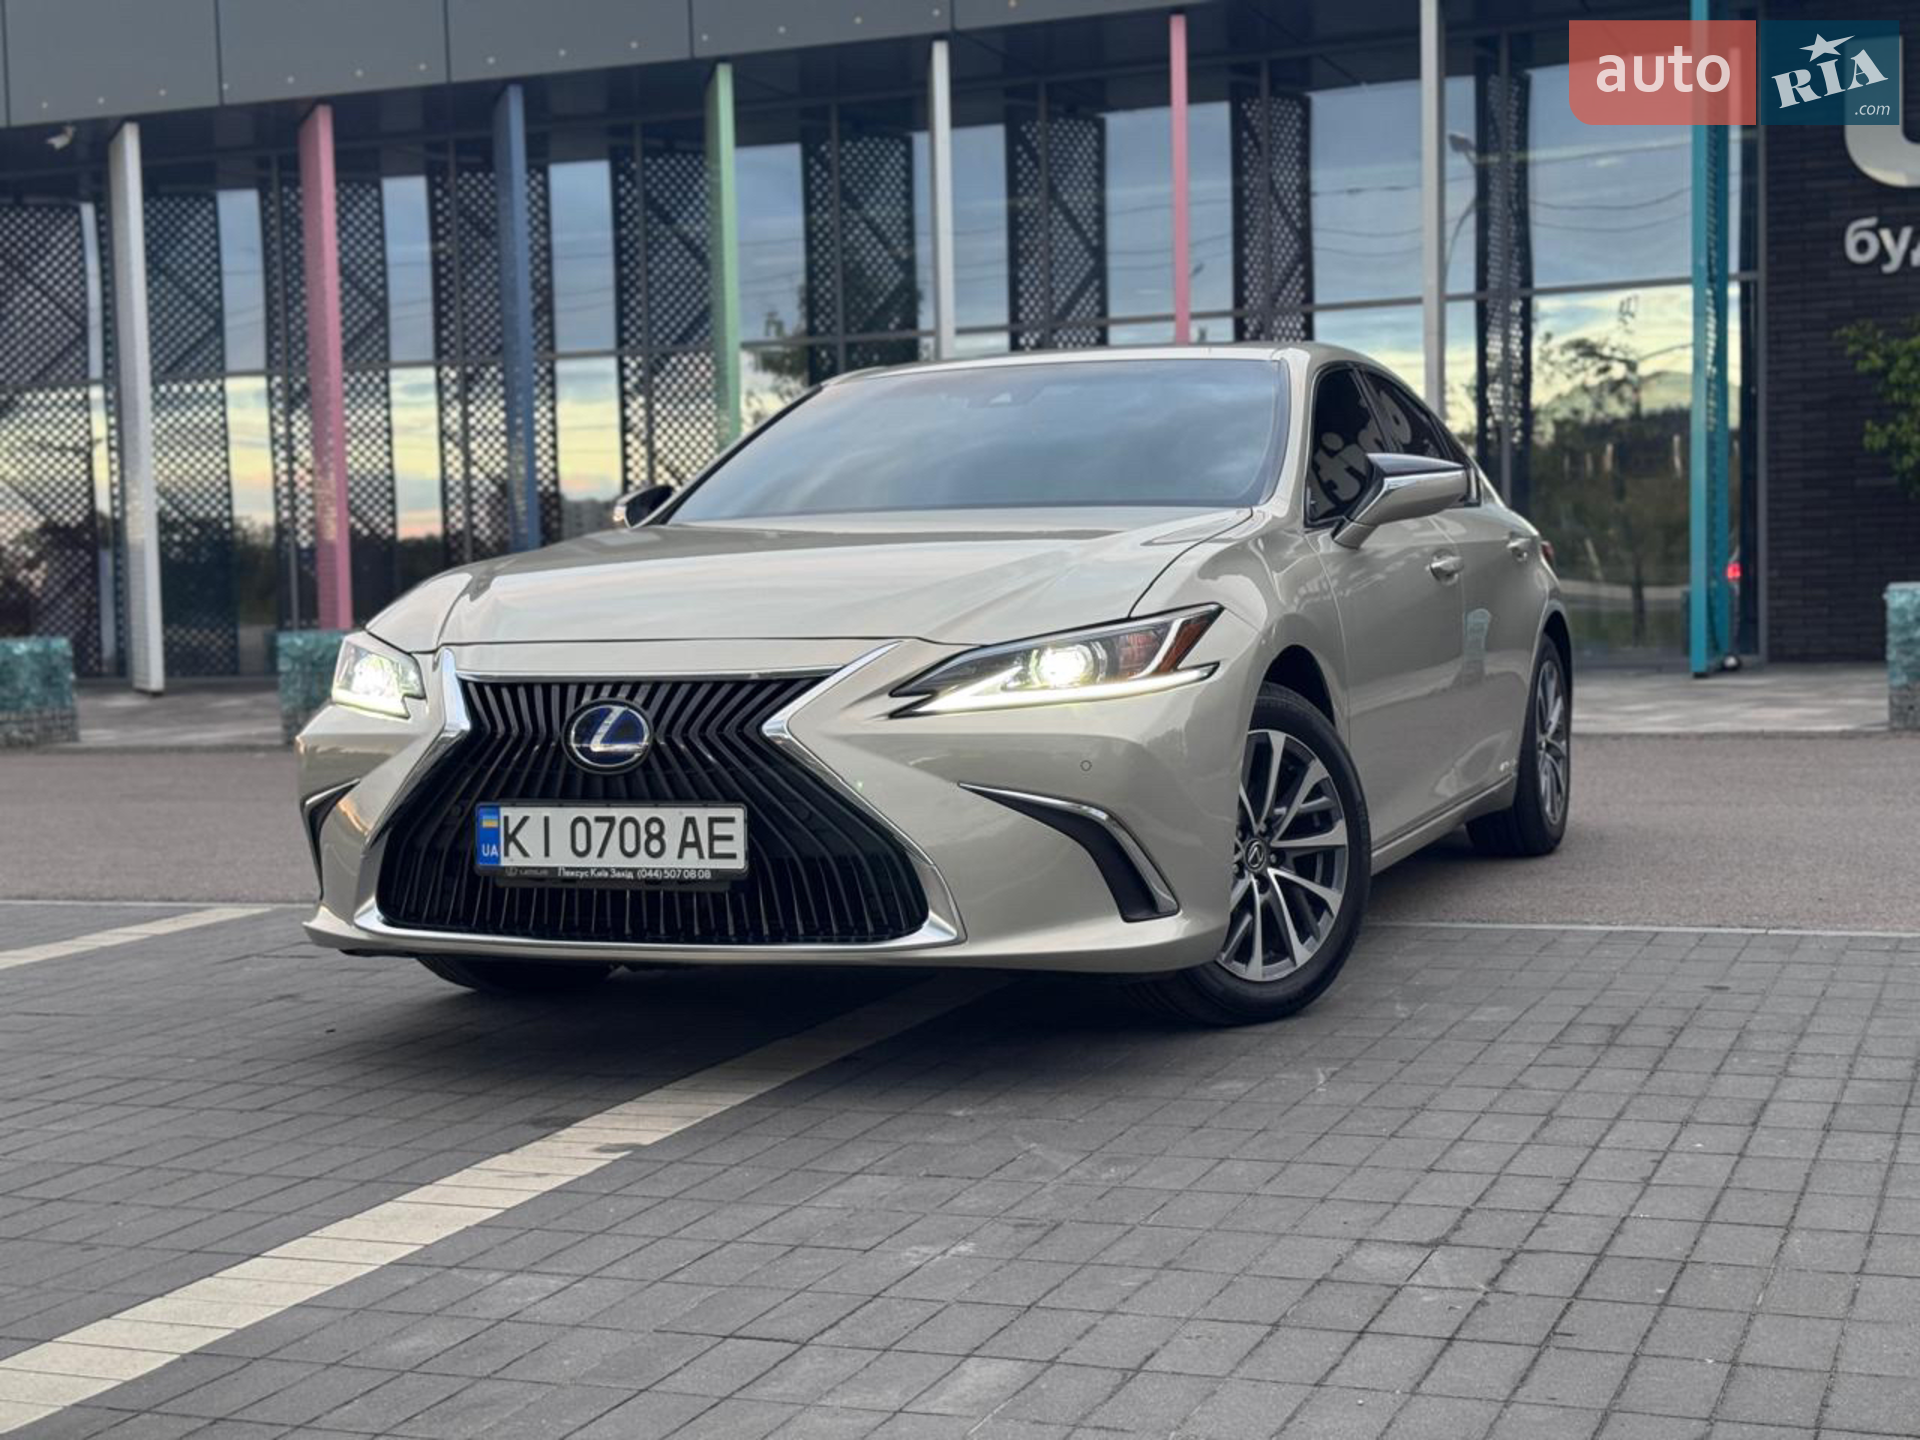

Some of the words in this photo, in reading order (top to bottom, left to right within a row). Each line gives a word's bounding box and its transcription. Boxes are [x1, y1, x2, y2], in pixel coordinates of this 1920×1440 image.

[570, 816, 667, 859] 0708
[677, 816, 738, 860] AE
[482, 843, 499, 857] UA
[637, 868, 662, 879] (044)
[664, 869, 681, 879] 507
[683, 869, 697, 879] 08
[698, 870, 712, 880] 08
